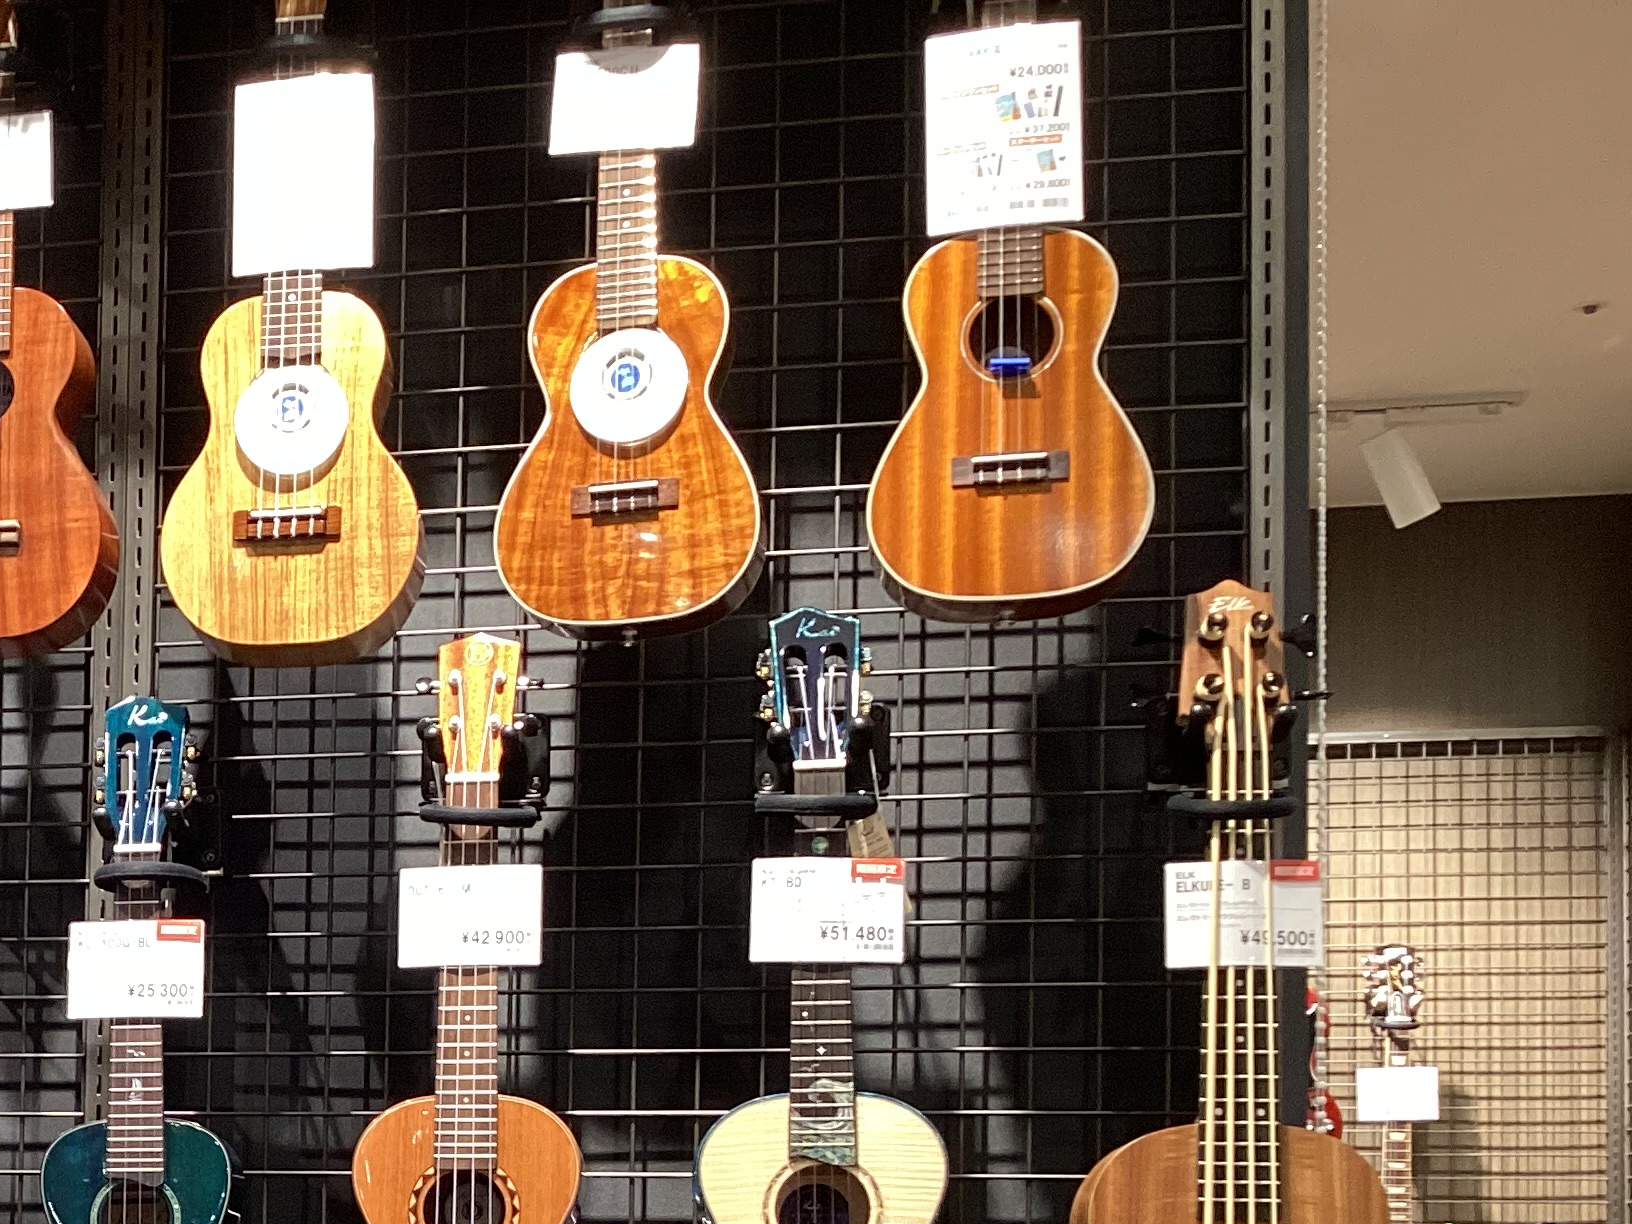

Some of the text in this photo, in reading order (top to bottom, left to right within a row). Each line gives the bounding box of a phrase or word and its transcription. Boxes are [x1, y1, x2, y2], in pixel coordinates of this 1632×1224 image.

[1208, 595, 1255, 613] Elk
[462, 930, 525, 945] ¥42900
[127, 983, 188, 998] ¥25300
